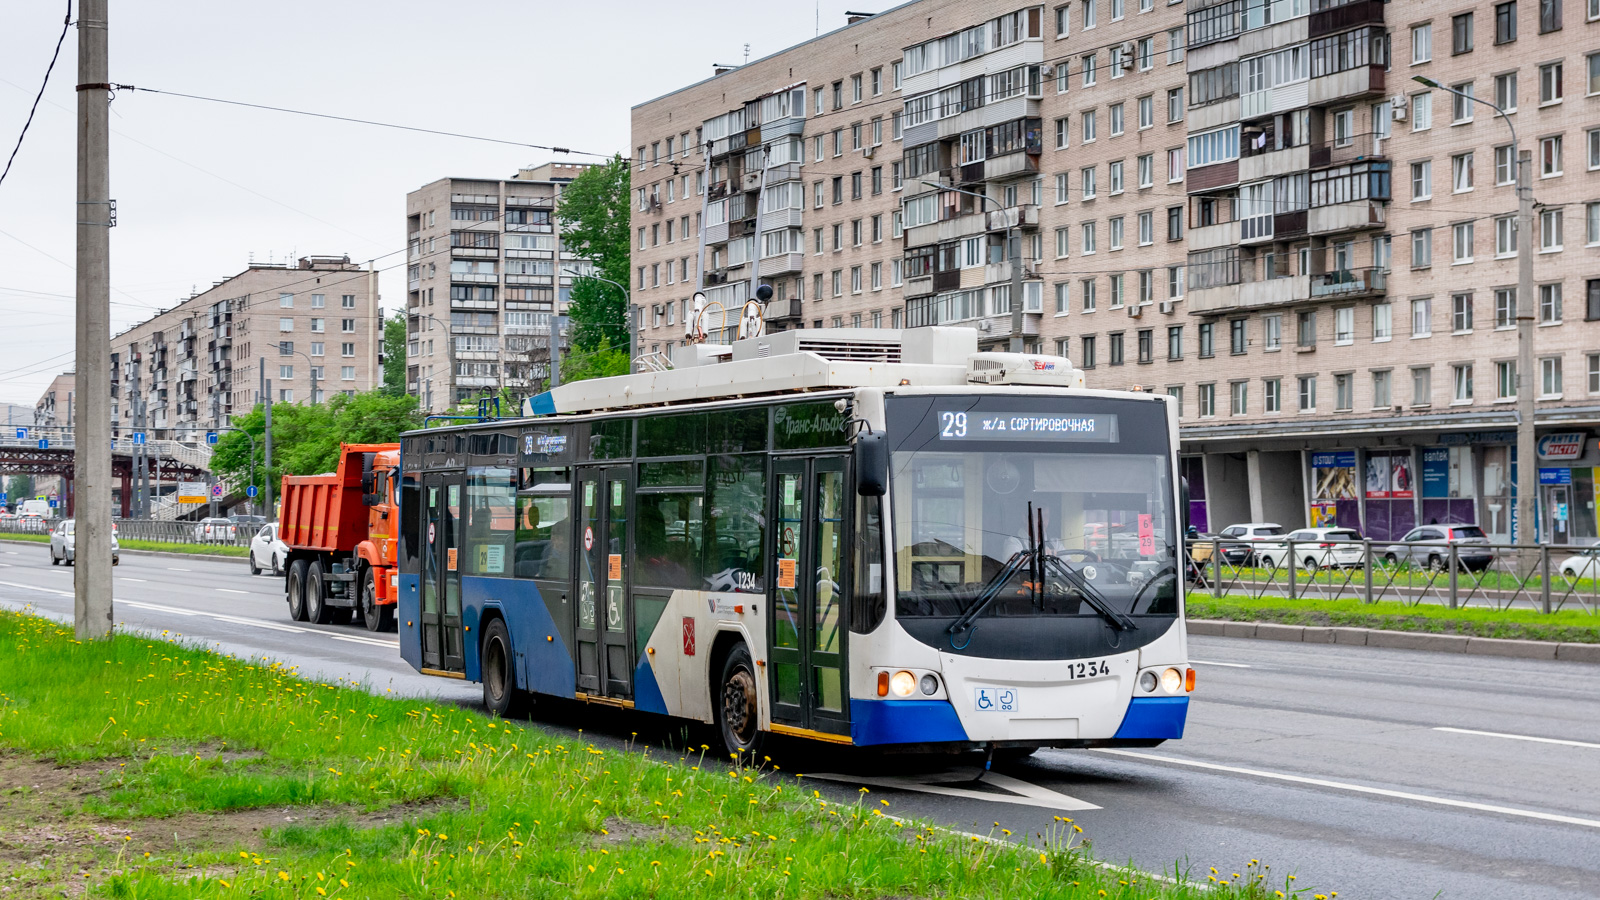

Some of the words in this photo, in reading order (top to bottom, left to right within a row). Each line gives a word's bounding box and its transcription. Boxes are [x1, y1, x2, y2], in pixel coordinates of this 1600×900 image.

[942, 412, 967, 437] 29
[983, 418, 1006, 430] ж/д
[1010, 418, 1095, 432] СОРТИРОВОЧНАЯ
[1547, 444, 1579, 455] МАСТЕР
[1424, 450, 1448, 461] santek
[1143, 519, 1149, 528] 6
[1142, 538, 1152, 547] 29
[738, 572, 756, 589] 1234
[1067, 660, 1110, 680] 1234
